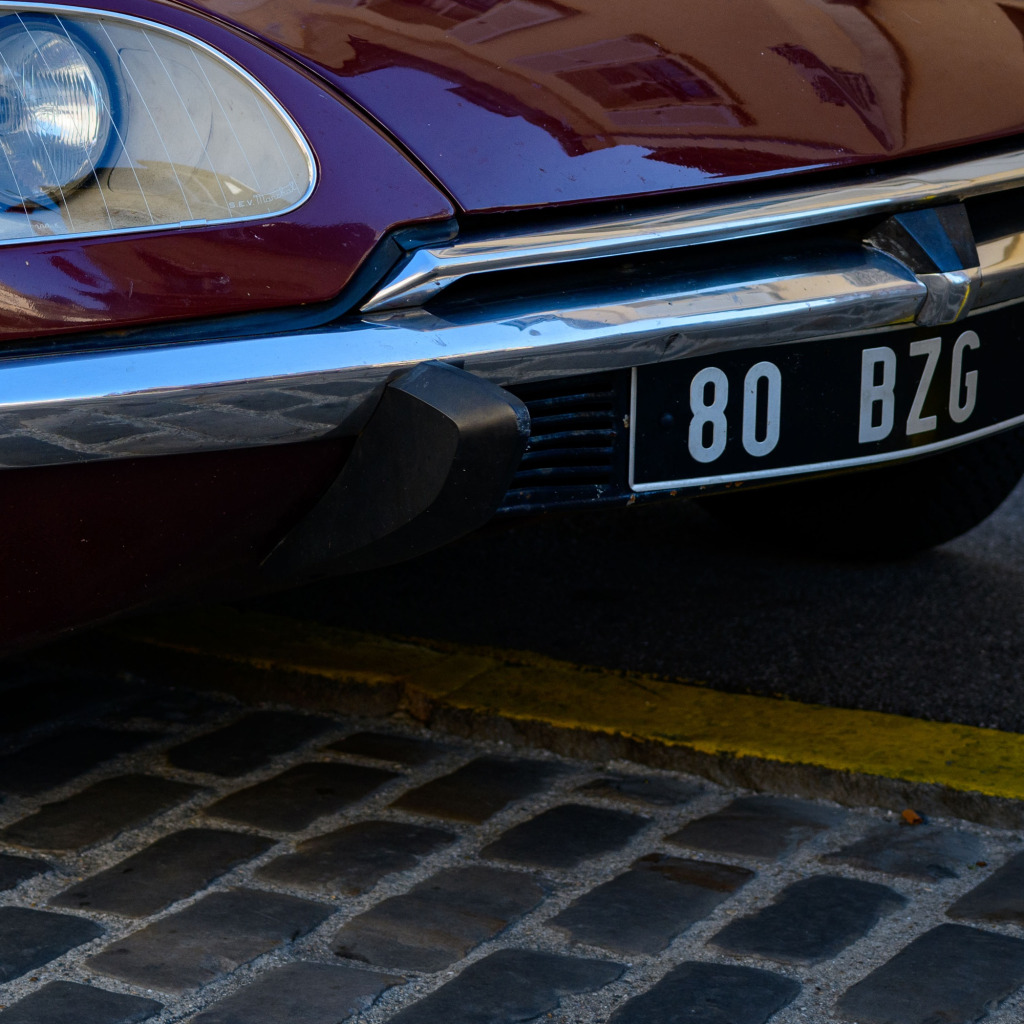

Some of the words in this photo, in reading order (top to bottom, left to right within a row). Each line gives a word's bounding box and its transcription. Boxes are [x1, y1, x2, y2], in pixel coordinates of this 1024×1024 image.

[228, 199, 255, 209] S.E.V.
[688, 360, 782, 464] 80
[858, 330, 981, 444] BZG
